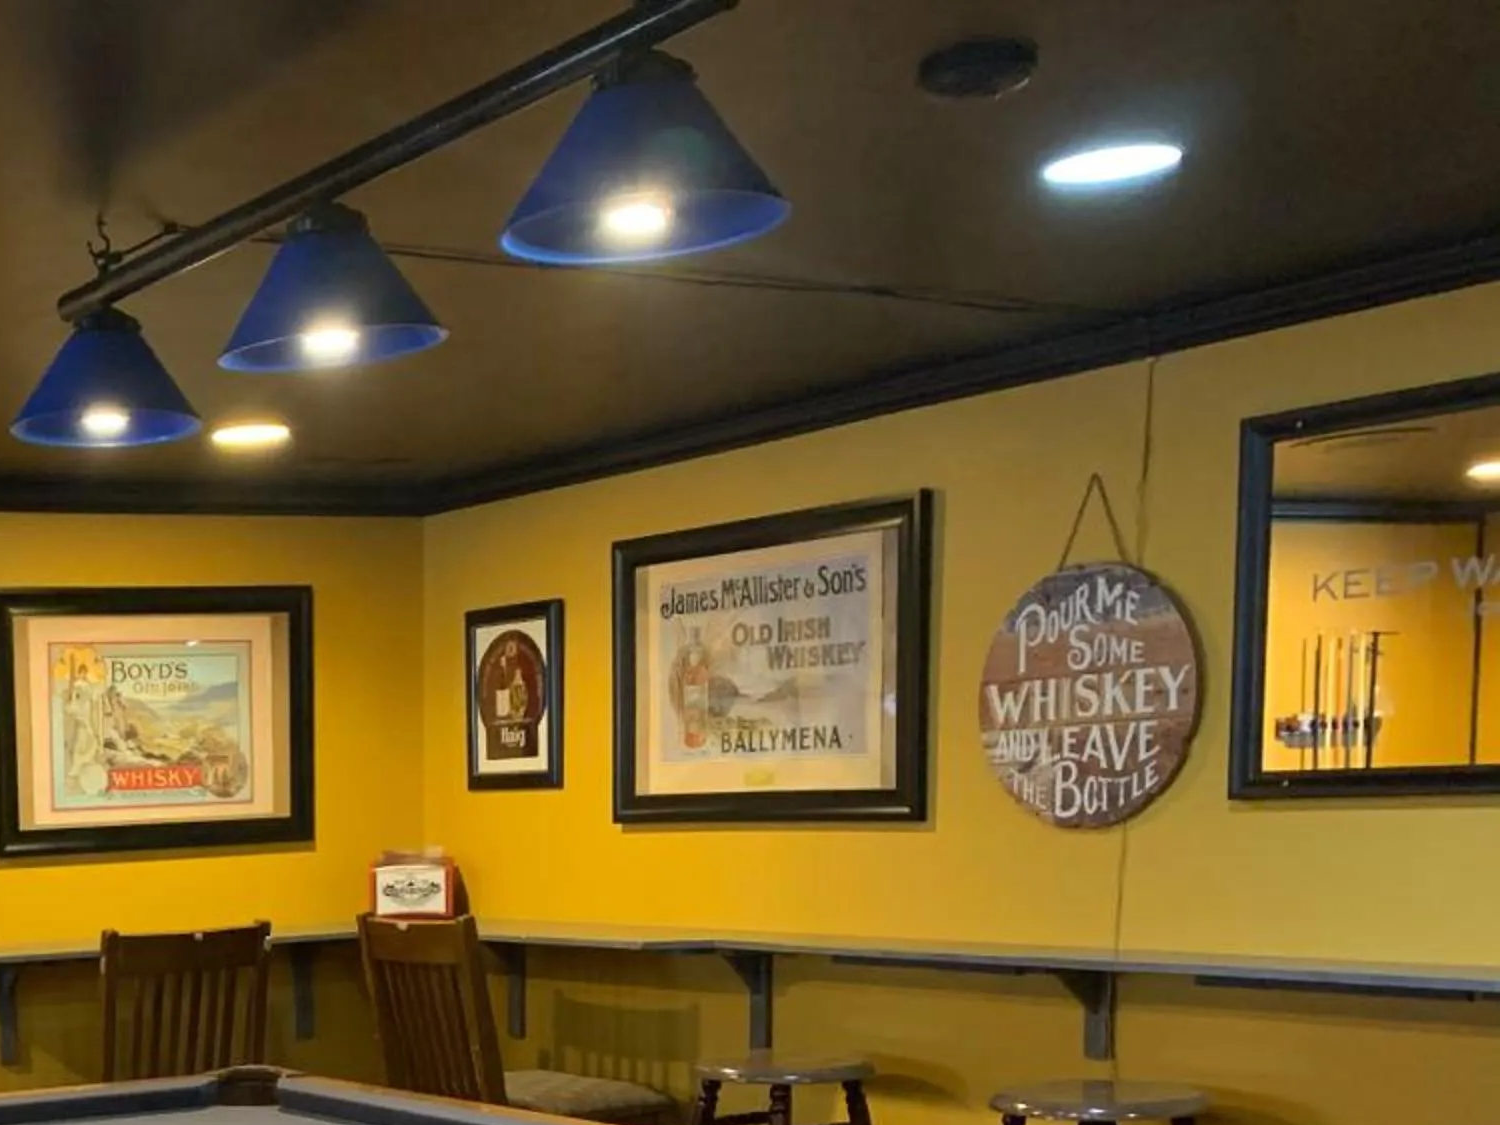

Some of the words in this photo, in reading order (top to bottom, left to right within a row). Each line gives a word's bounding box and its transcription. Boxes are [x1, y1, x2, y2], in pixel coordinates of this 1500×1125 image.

[660, 587, 719, 619] James
[804, 578, 814, 599] &
[818, 564, 866, 596] Son's
[1312, 560, 1438, 602] KEEP
[731, 622, 773, 647] OLD
[777, 616, 831, 643] IRISH
[1015, 582, 1099, 675] POUR
[1097, 576, 1140, 625] ME
[1067, 624, 1145, 670] SOME
[767, 641, 866, 670] WHISKEY
[984, 663, 1192, 729] WHISKEY
[721, 725, 842, 753] BALLYMENA
[995, 730, 1036, 763] AND
[1035, 720, 1161, 771] LEAVE
[111, 767, 198, 787] WHISKY
[1010, 767, 1047, 809] THE
[1052, 759, 1159, 818] BOTTLE
